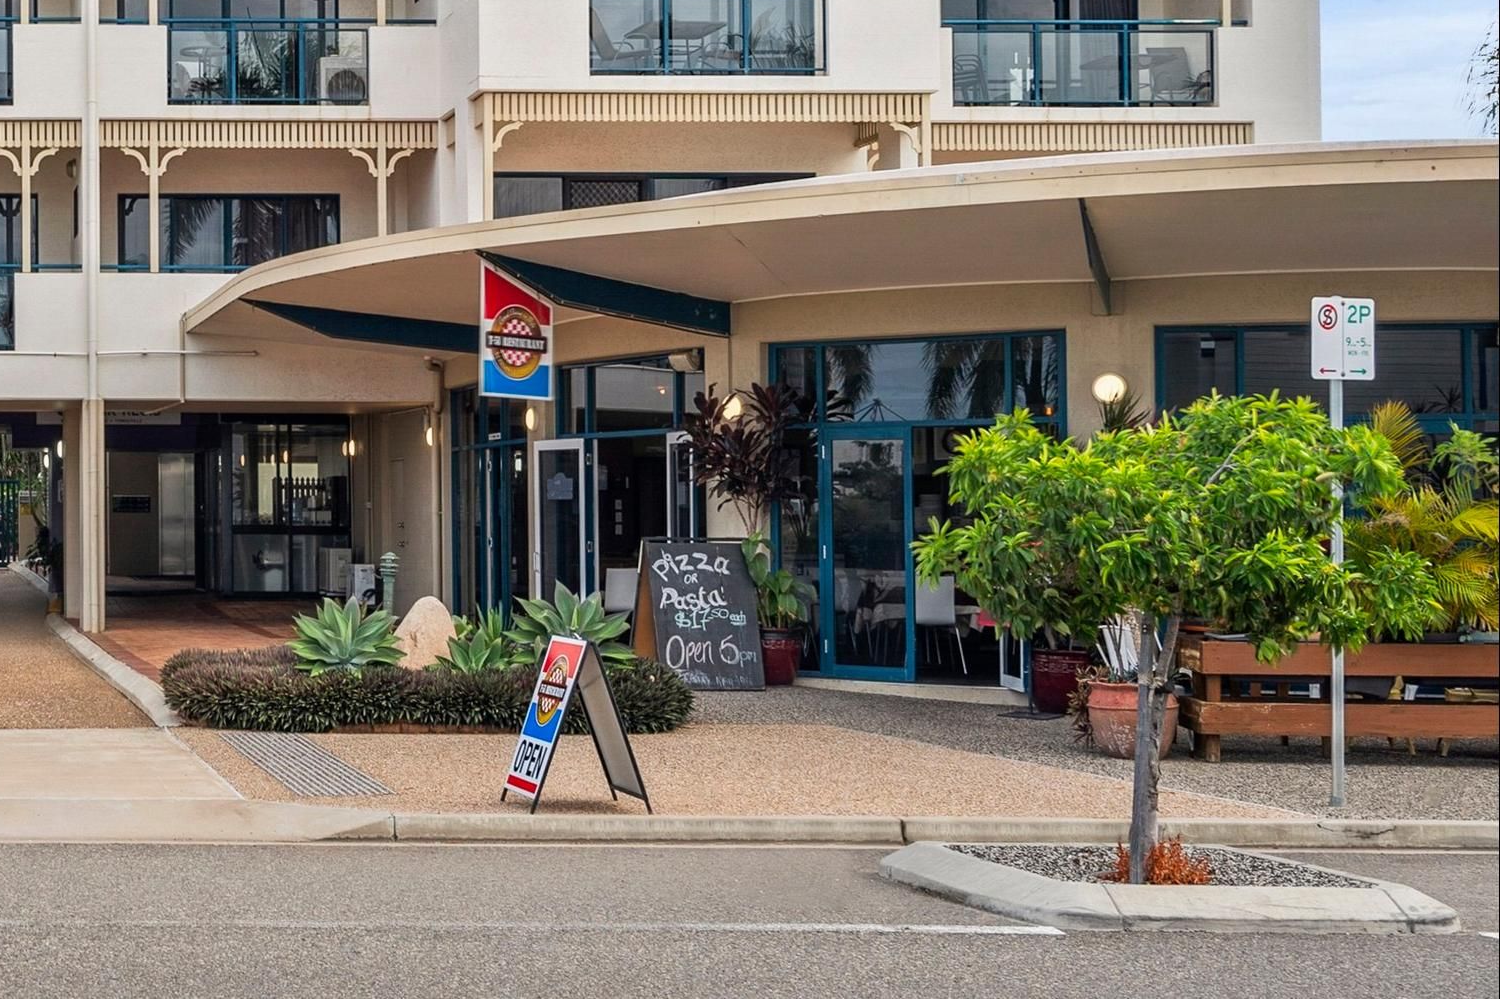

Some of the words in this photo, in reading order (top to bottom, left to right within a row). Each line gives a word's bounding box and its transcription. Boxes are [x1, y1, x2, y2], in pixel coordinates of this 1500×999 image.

[1347, 304, 1371, 324] 2P
[666, 634, 715, 669] Open
[513, 739, 548, 779] OPEN
